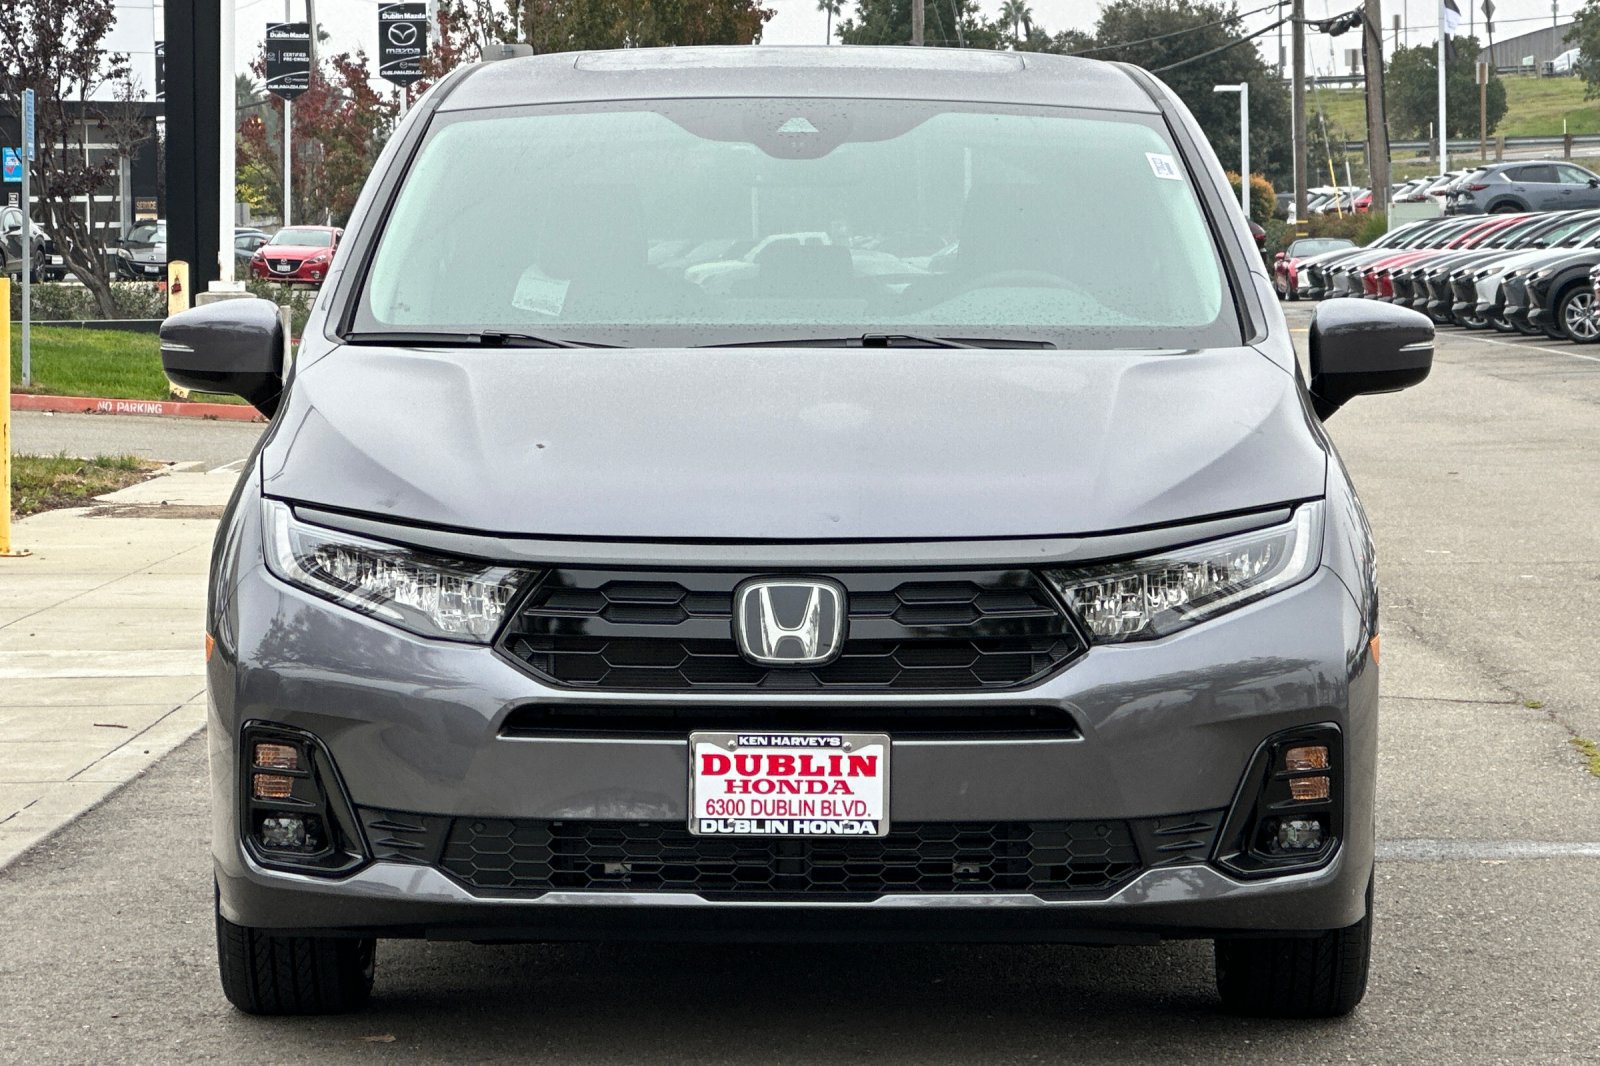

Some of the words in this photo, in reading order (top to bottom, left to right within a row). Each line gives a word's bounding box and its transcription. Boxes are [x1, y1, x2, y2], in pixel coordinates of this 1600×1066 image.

[97, 401, 112, 412] NO
[117, 402, 162, 414] PARKING
[739, 736, 768, 746] KEN
[771, 736, 841, 747] HARVEY'S
[701, 754, 877, 777] DUBLIN
[724, 779, 855, 795] HONDA
[705, 798, 745, 816] 6300
[751, 799, 815, 816] DUBLIN
[821, 800, 871, 817] BLVD.
[701, 819, 789, 834] DUBLIN
[793, 820, 877, 835] HONDA
